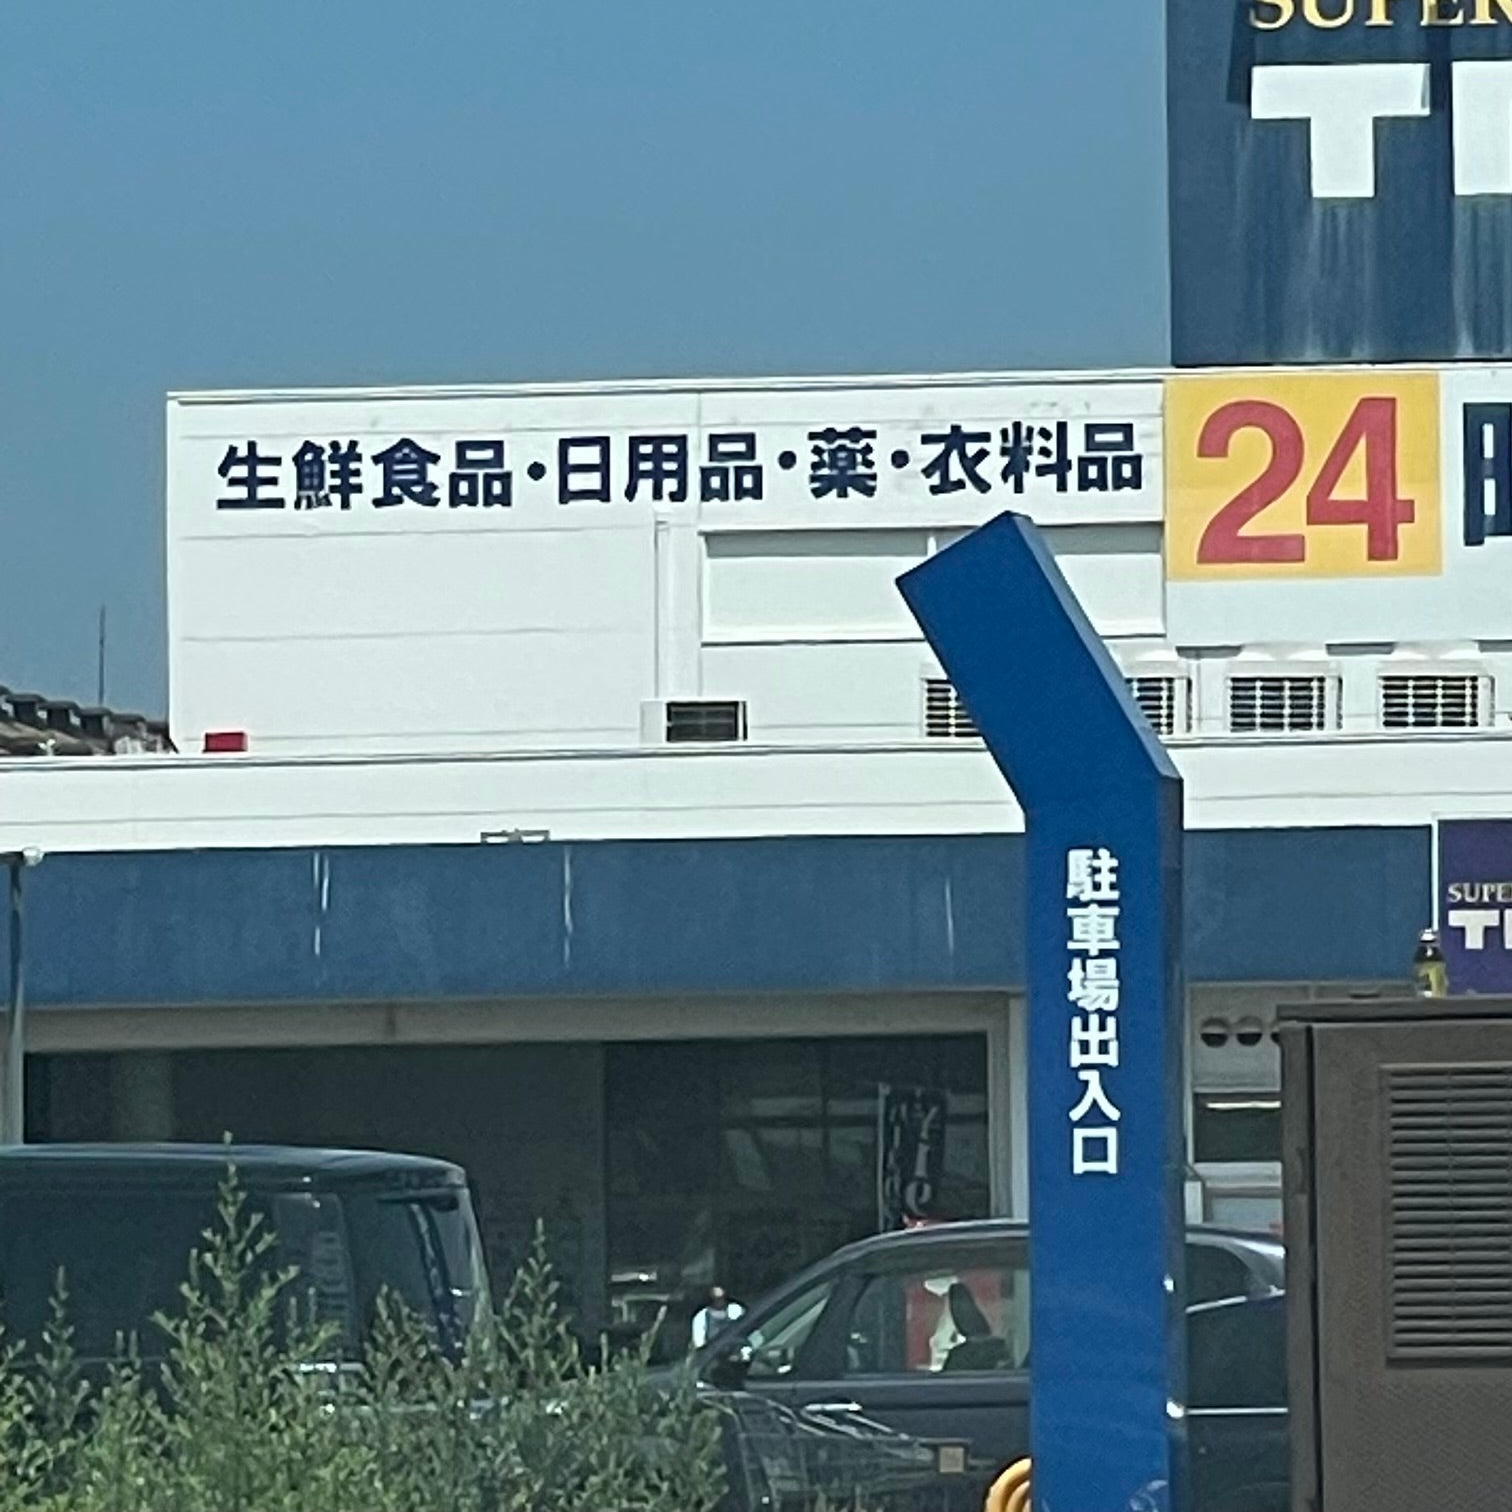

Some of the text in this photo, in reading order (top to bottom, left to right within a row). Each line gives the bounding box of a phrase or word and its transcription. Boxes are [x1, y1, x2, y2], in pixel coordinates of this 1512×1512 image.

[1066, 848, 1121, 1175] 駐車場出入口
